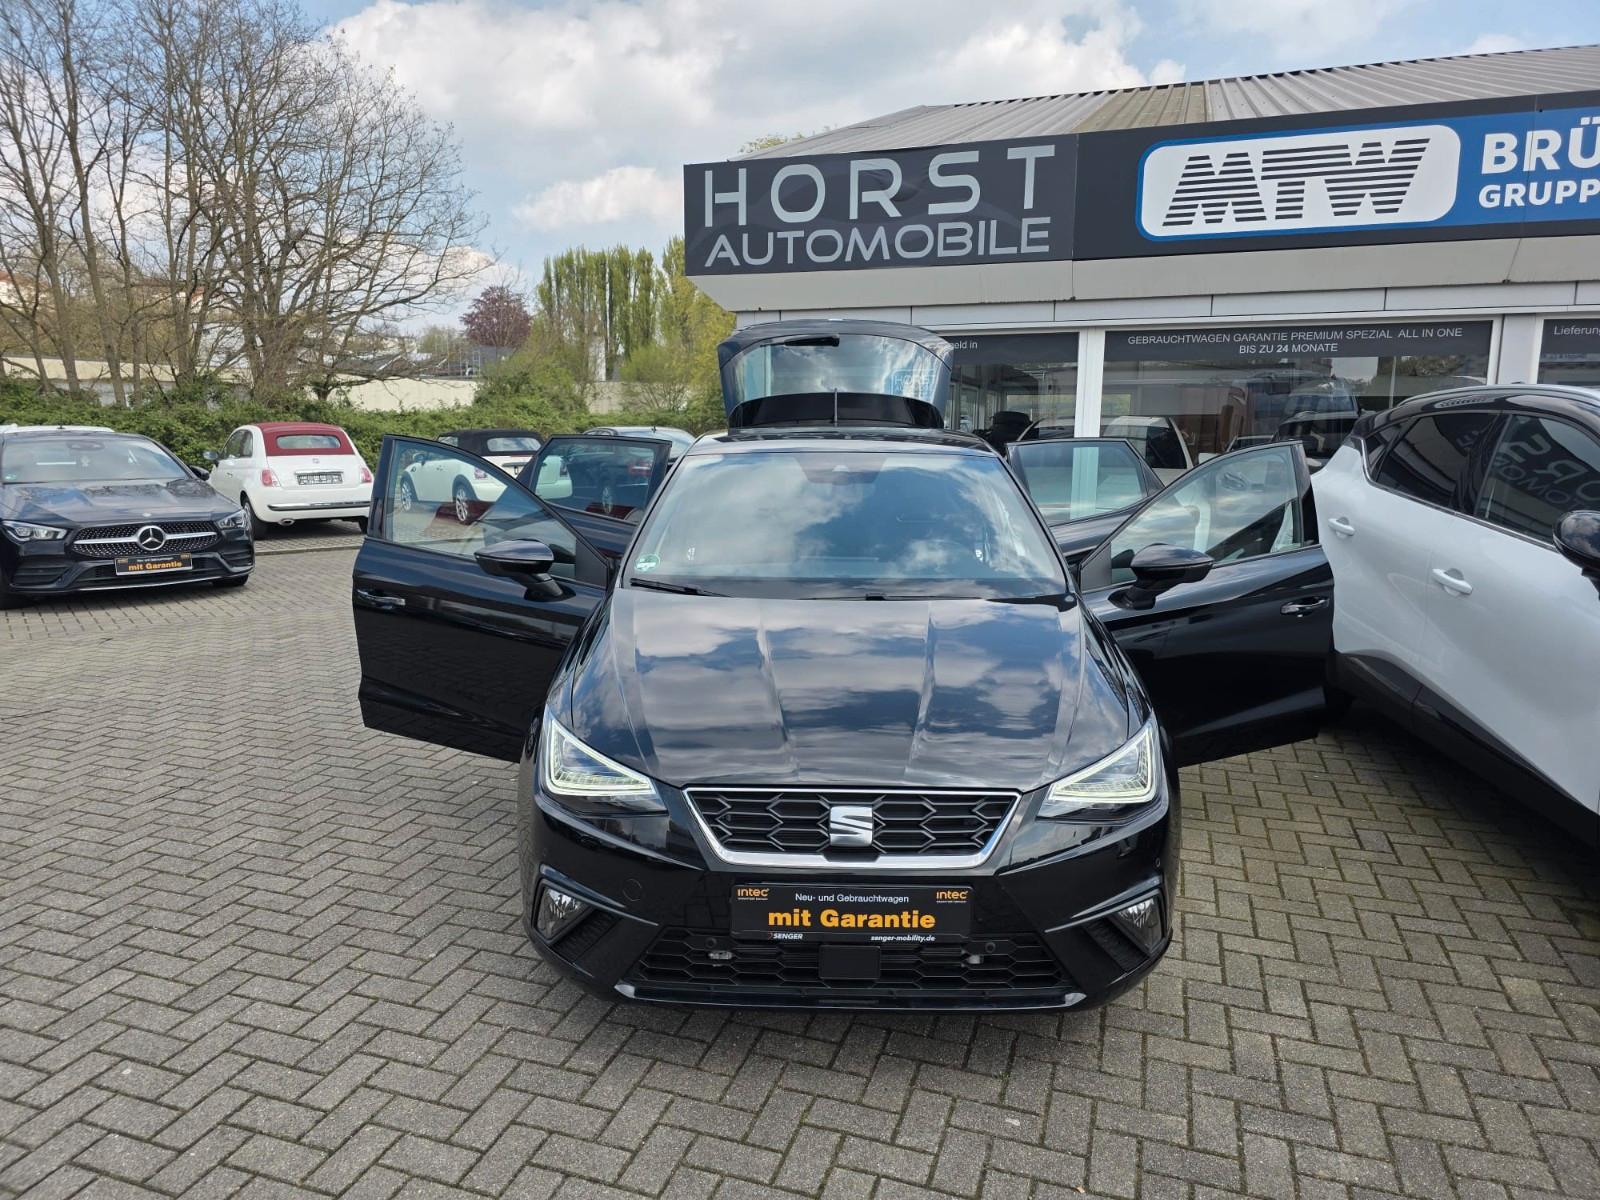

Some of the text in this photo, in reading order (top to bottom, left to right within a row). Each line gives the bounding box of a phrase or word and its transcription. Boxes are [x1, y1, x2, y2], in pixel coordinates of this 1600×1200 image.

[1481, 116, 1600, 174] BRÜ
[704, 144, 1056, 227] HORST
[1162, 138, 1431, 227] MTW
[1478, 178, 1600, 209] GRUPP
[704, 216, 1051, 267] AUTOMOBILE
[1554, 325, 1600, 335] Lieferun
[1127, 327, 1463, 345] GEBRAUCHTWAGEN GARANTIE PREMIUM SPEZIAL ALL IN ONE
[970, 340, 978, 350] in
[1239, 343, 1339, 354] BIS ZU 24 MONATE
[128, 563, 144, 571] mit
[145, 560, 183, 570] Garantie
[737, 887, 769, 897] intec
[936, 890, 968, 900] intec
[795, 893, 910, 905] Neu- und Gebrauchtwagen
[768, 908, 936, 929] mit Garantie
[773, 932, 804, 940] SENGER
[870, 934, 937, 943] senger-mobility.de
